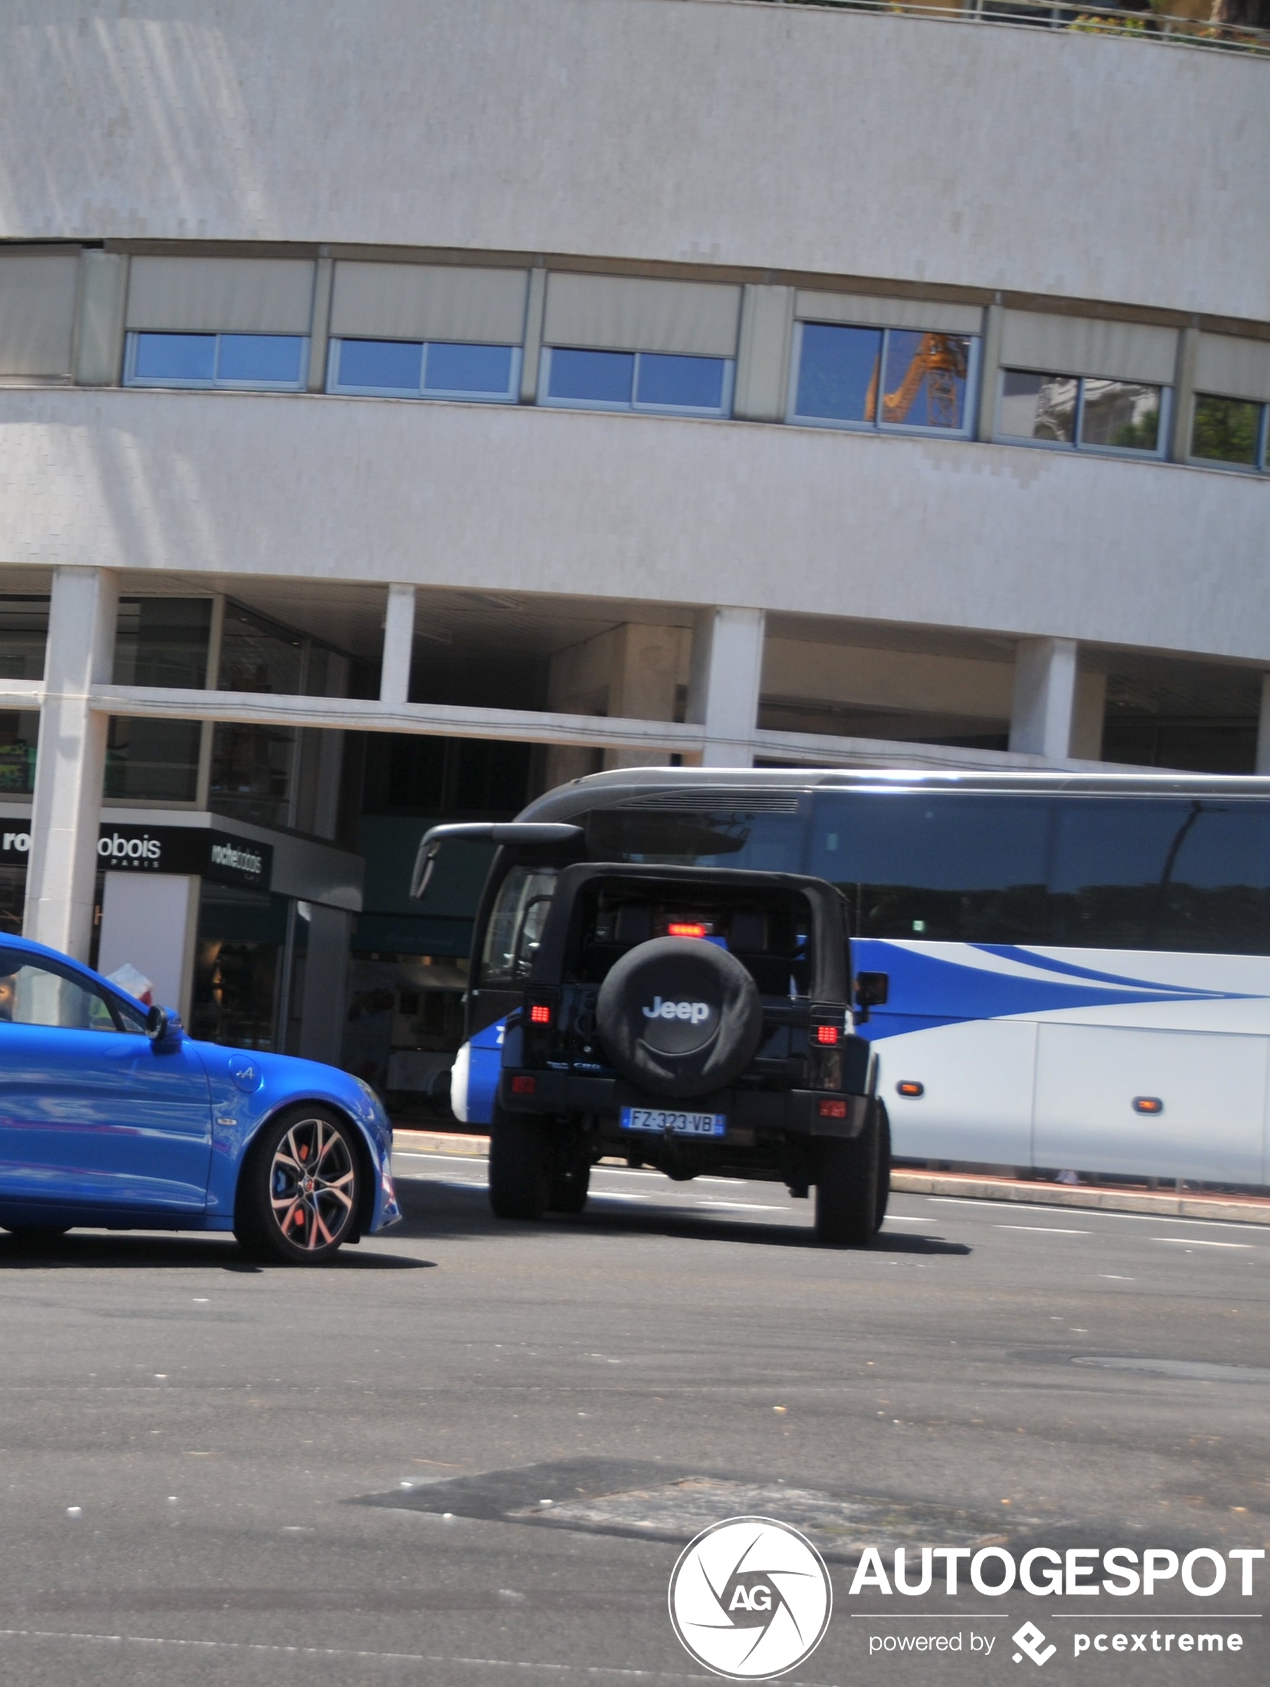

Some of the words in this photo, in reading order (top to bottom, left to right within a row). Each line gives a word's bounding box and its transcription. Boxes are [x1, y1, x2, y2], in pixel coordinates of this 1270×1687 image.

[111, 859, 160, 868] PARIS
[642, 996, 709, 1024] Jeep
[632, 1110, 713, 1132] FZ-323-VB
